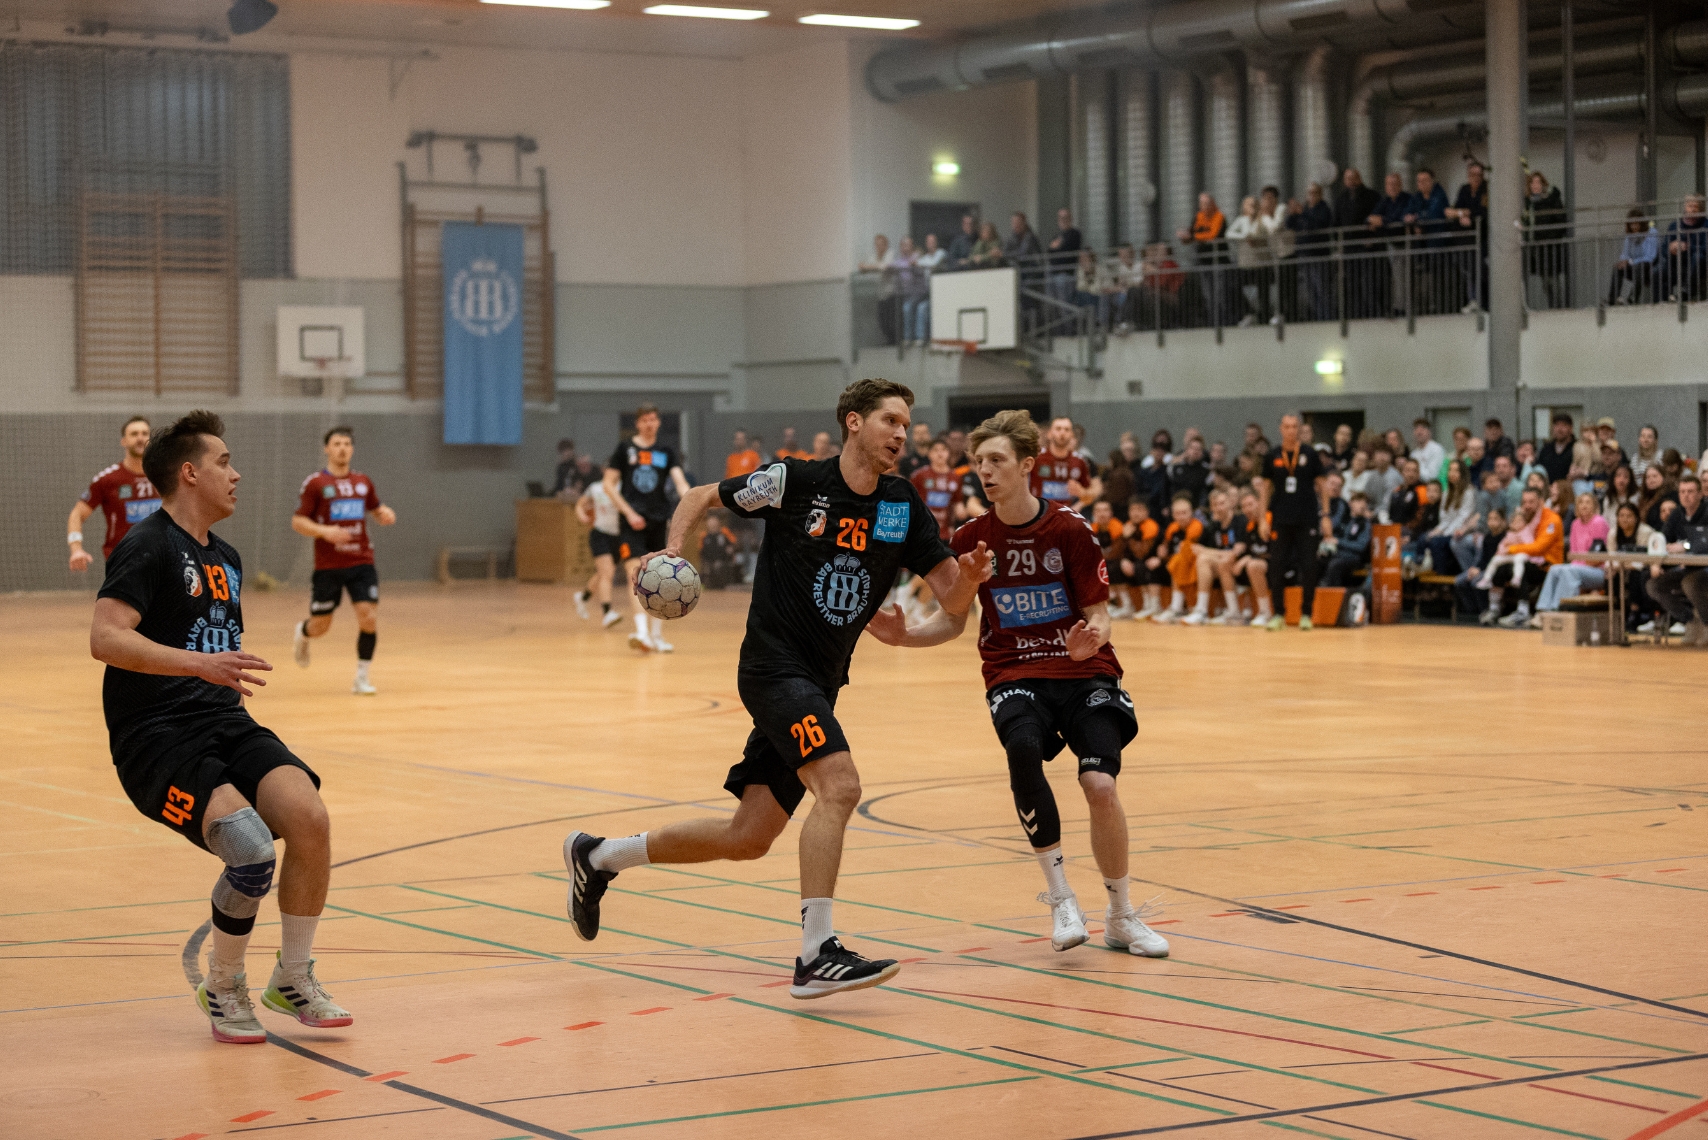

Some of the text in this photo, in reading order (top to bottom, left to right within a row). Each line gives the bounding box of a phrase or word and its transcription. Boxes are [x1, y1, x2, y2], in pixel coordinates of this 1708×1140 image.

[737, 477, 774, 502] KLINIKUM
[741, 485, 778, 507] BAYREUTH
[811, 500, 831, 508] erima
[879, 503, 909, 516] STADT
[836, 517, 869, 552] 26
[876, 528, 905, 539] Bayreuth
[1006, 549, 1036, 577] 29
[813, 562, 871, 627] BAYREUTHER BRAUHAUS
[1015, 588, 1066, 612] BITE
[790, 714, 827, 758] 26
[161, 785, 195, 826] 43
